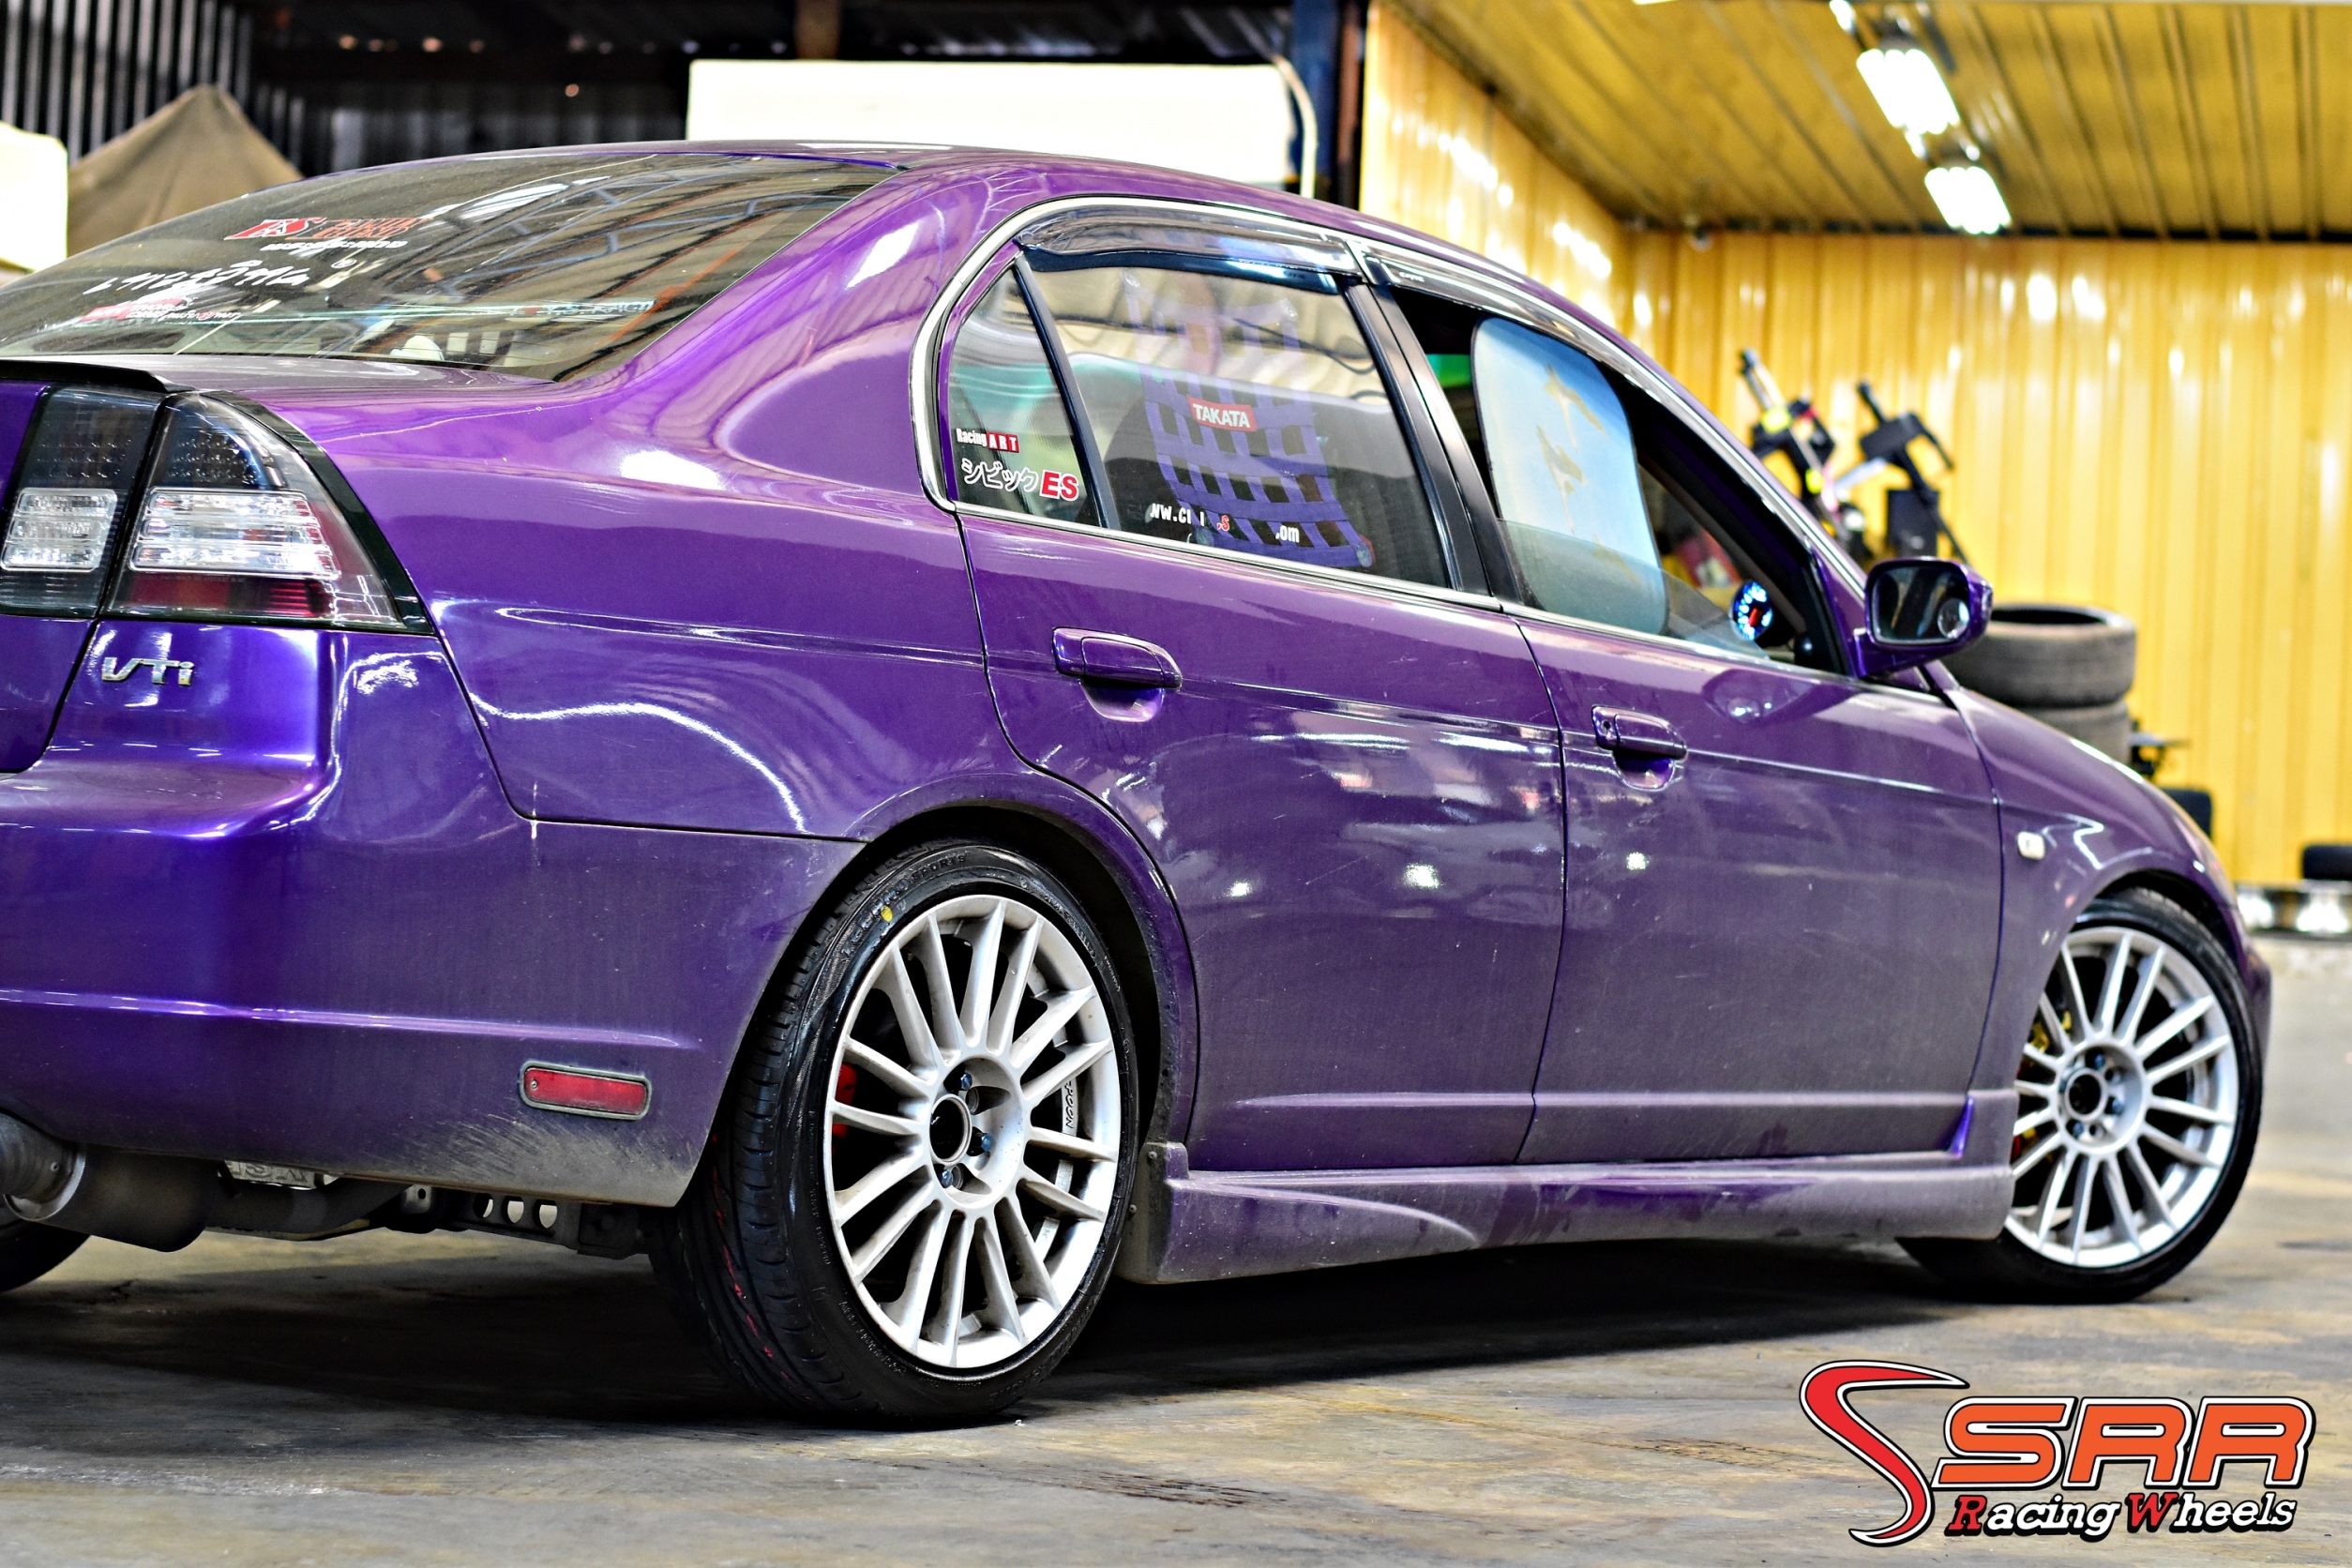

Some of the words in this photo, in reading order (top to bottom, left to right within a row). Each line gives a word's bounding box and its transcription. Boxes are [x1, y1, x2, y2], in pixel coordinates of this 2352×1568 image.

[1192, 402, 1251, 429] TAKATA
[956, 428, 988, 447] Racing
[988, 433, 1018, 452] ART
[961, 458, 1039, 492] シビック
[1039, 470, 1078, 501] ES
